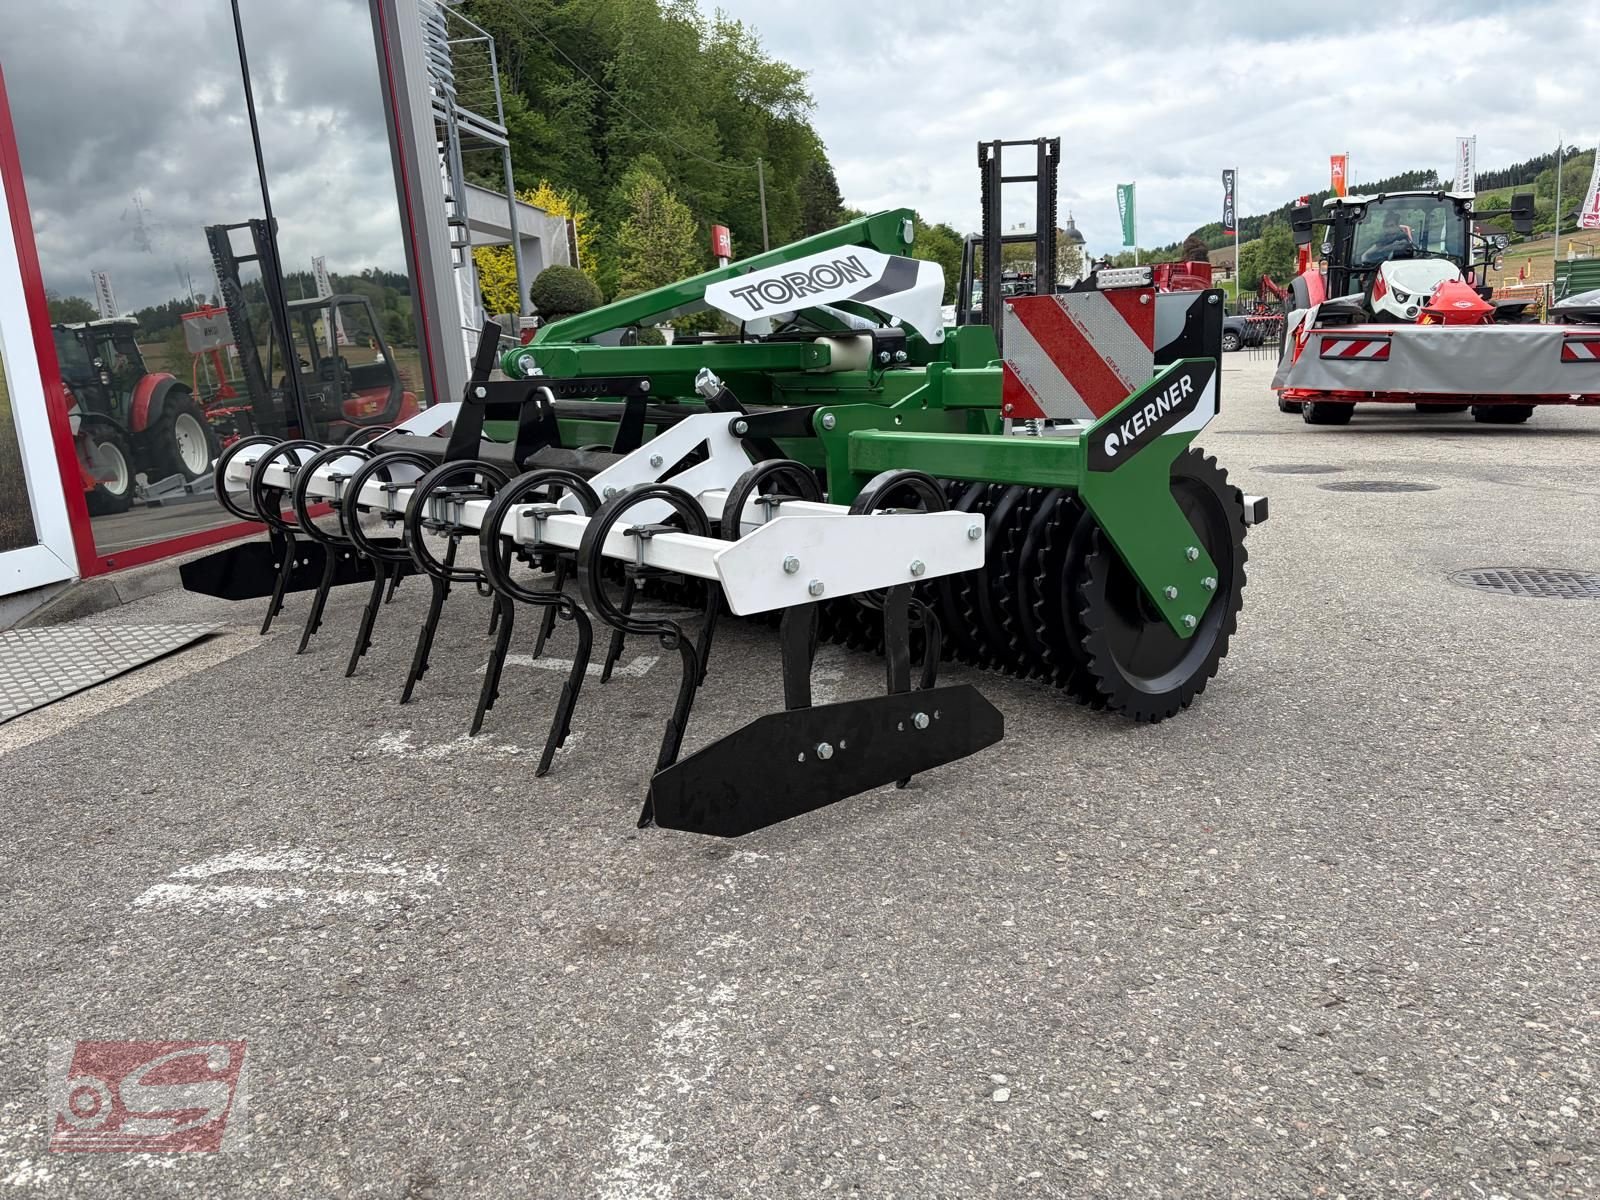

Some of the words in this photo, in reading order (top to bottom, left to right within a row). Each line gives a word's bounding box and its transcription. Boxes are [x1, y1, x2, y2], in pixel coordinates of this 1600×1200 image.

[729, 255, 872, 312] TORON
[1007, 359, 1021, 376] GEKA
[1105, 356, 1120, 375] GEKA
[1120, 374, 1194, 446] KERNER
